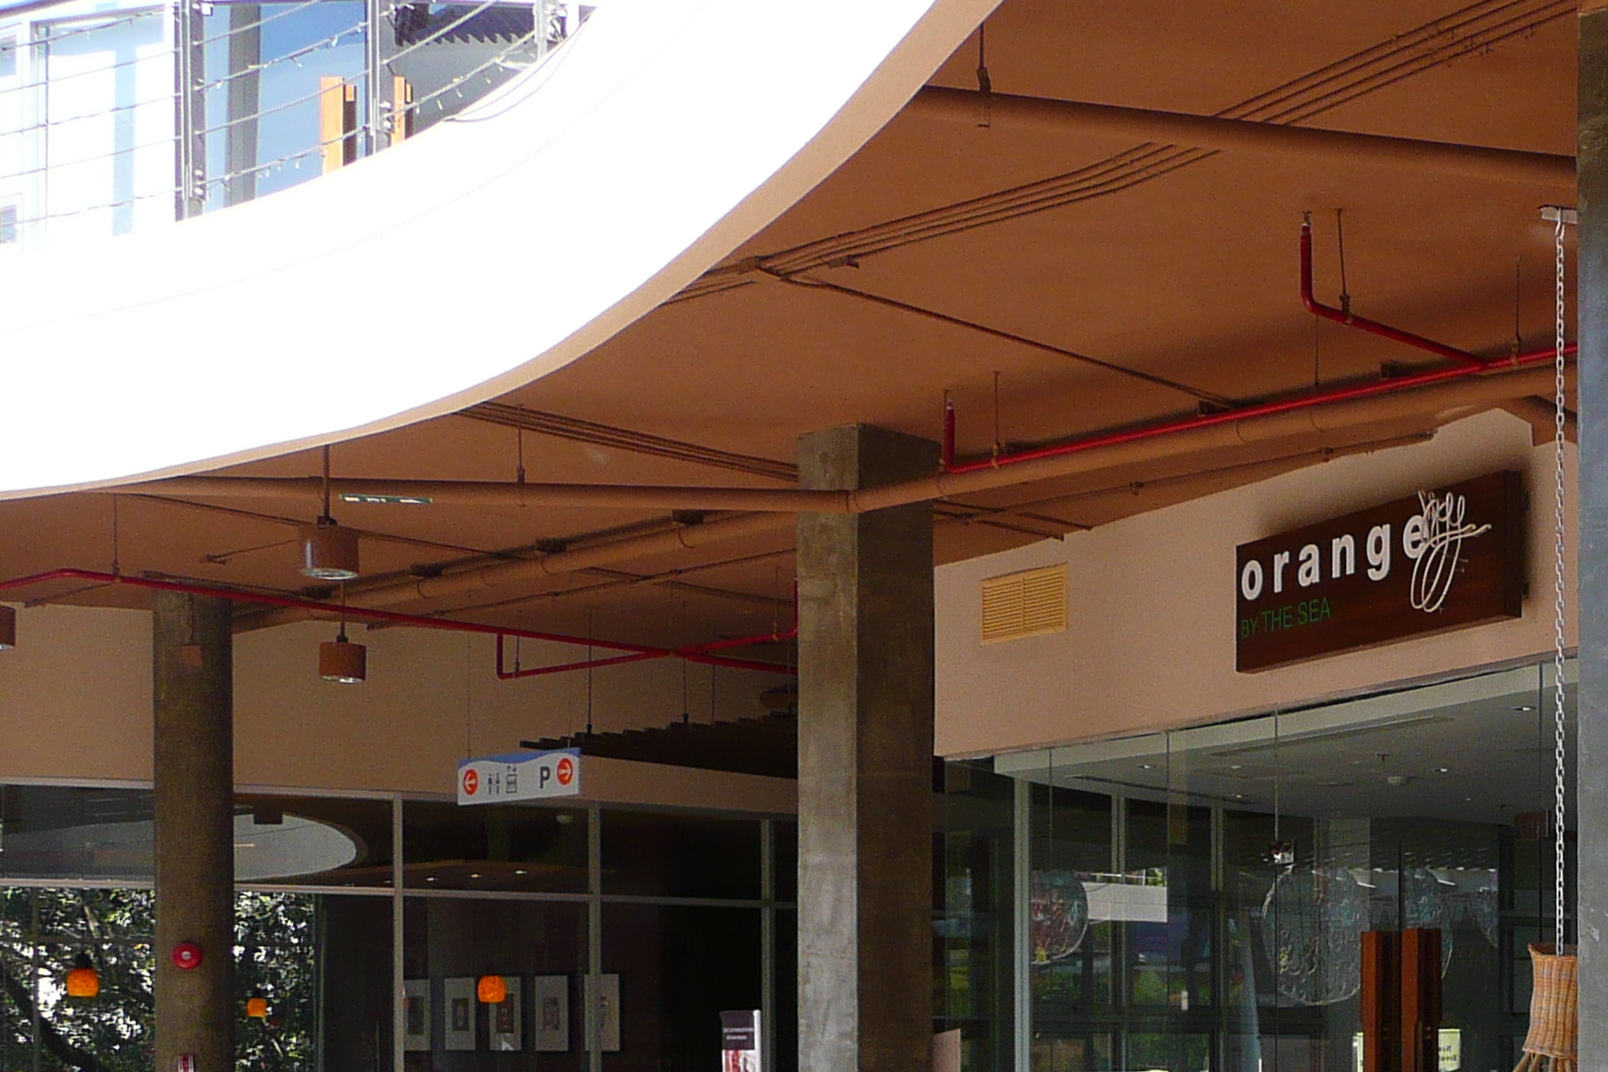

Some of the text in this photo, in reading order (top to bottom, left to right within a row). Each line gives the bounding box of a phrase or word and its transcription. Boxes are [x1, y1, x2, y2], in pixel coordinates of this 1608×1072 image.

[1241, 596, 1332, 638] BY THE SEA
[539, 766, 551, 789] P
